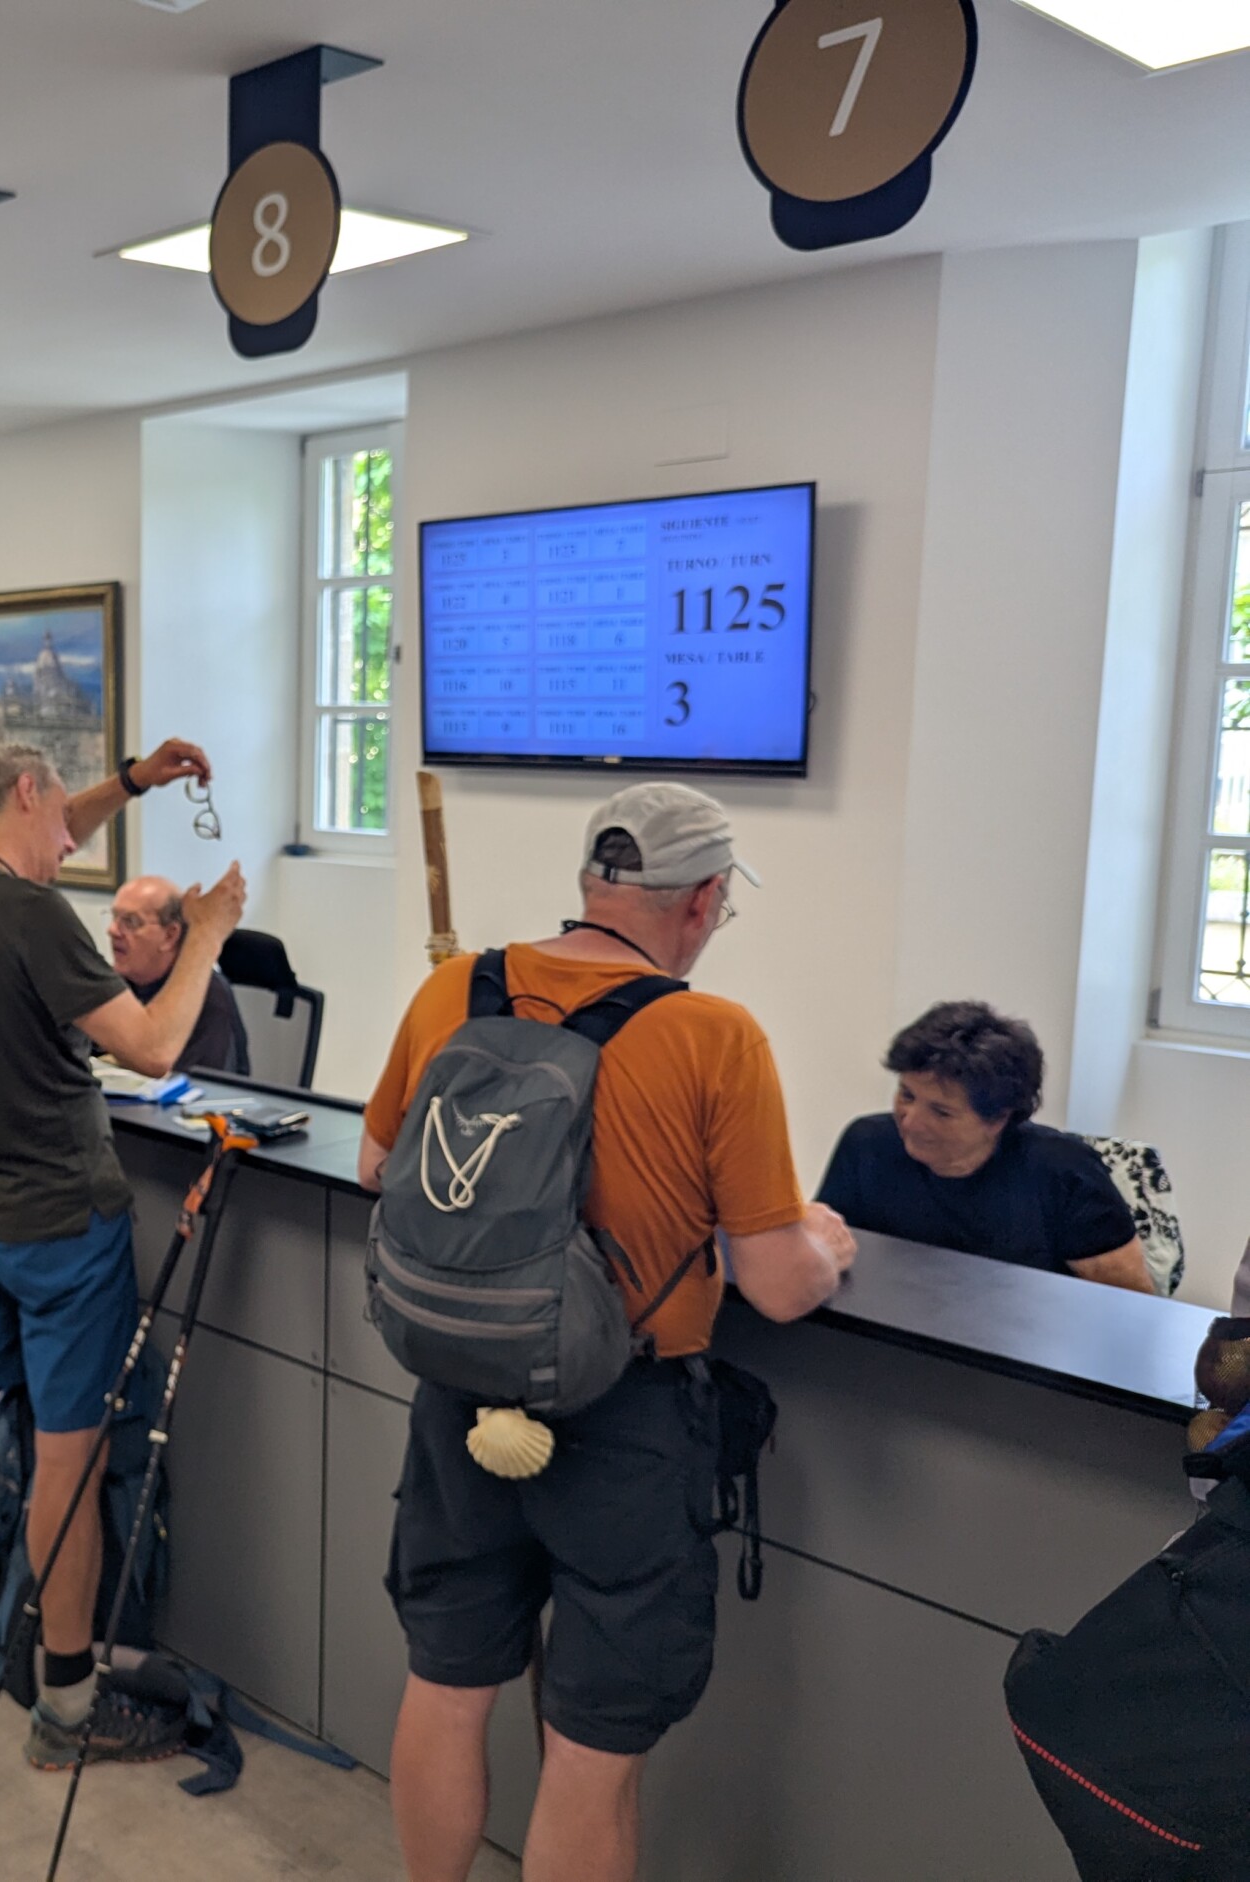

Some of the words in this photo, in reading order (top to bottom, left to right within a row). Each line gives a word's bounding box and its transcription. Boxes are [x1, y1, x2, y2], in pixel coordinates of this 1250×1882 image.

[818, 17, 883, 137] 7
[251, 192, 291, 277] 8
[667, 557, 718, 572] TURNO
[730, 553, 773, 568] TURN
[670, 582, 786, 634] 1125
[665, 652, 704, 665] MESA
[717, 650, 765, 665] TABLE
[664, 681, 691, 727] 3
